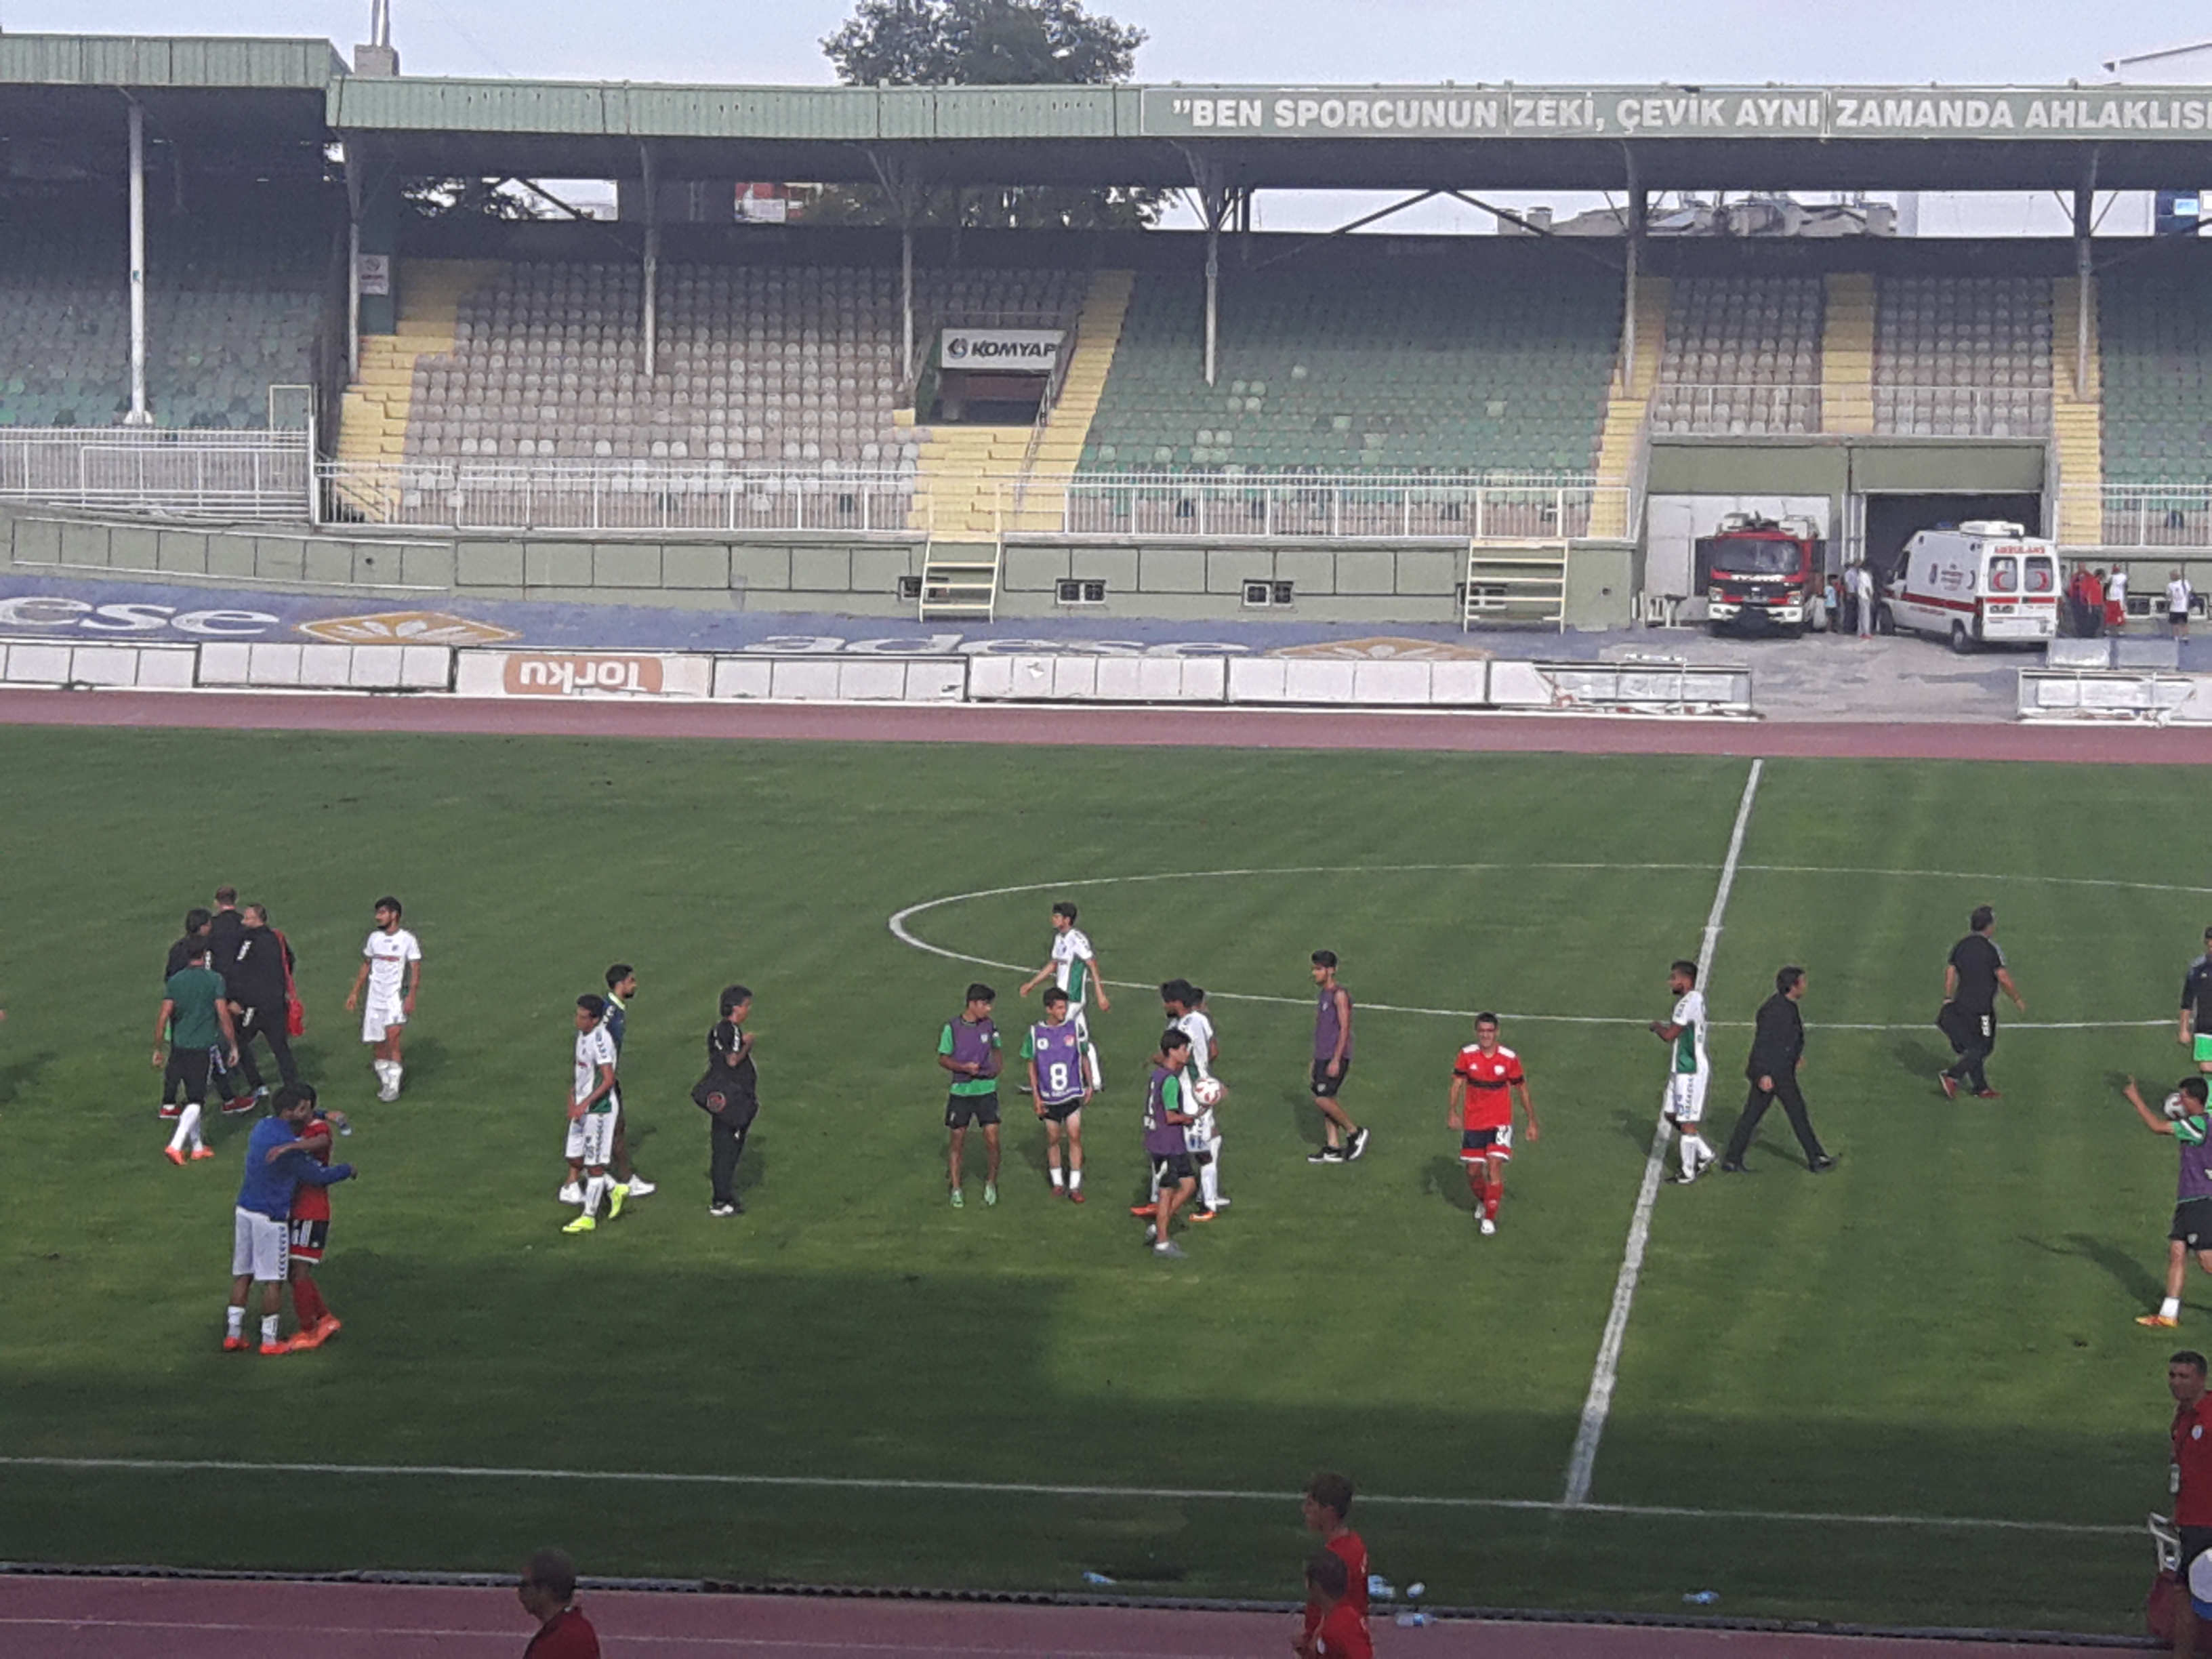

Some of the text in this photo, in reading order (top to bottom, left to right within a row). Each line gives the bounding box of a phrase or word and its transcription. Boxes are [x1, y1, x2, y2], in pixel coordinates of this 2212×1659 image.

[1274, 99, 1498, 128] SPORCUNUN
[1513, 91, 1605, 131] ZEKİ,
[1616, 93, 1725, 134] ÇEVİK
[1735, 99, 1819, 127] AYNI
[1836, 100, 2015, 128] ZAMANDA
[971, 340, 1057, 358] KOMYAP
[1050, 1062, 1068, 1090] 8
